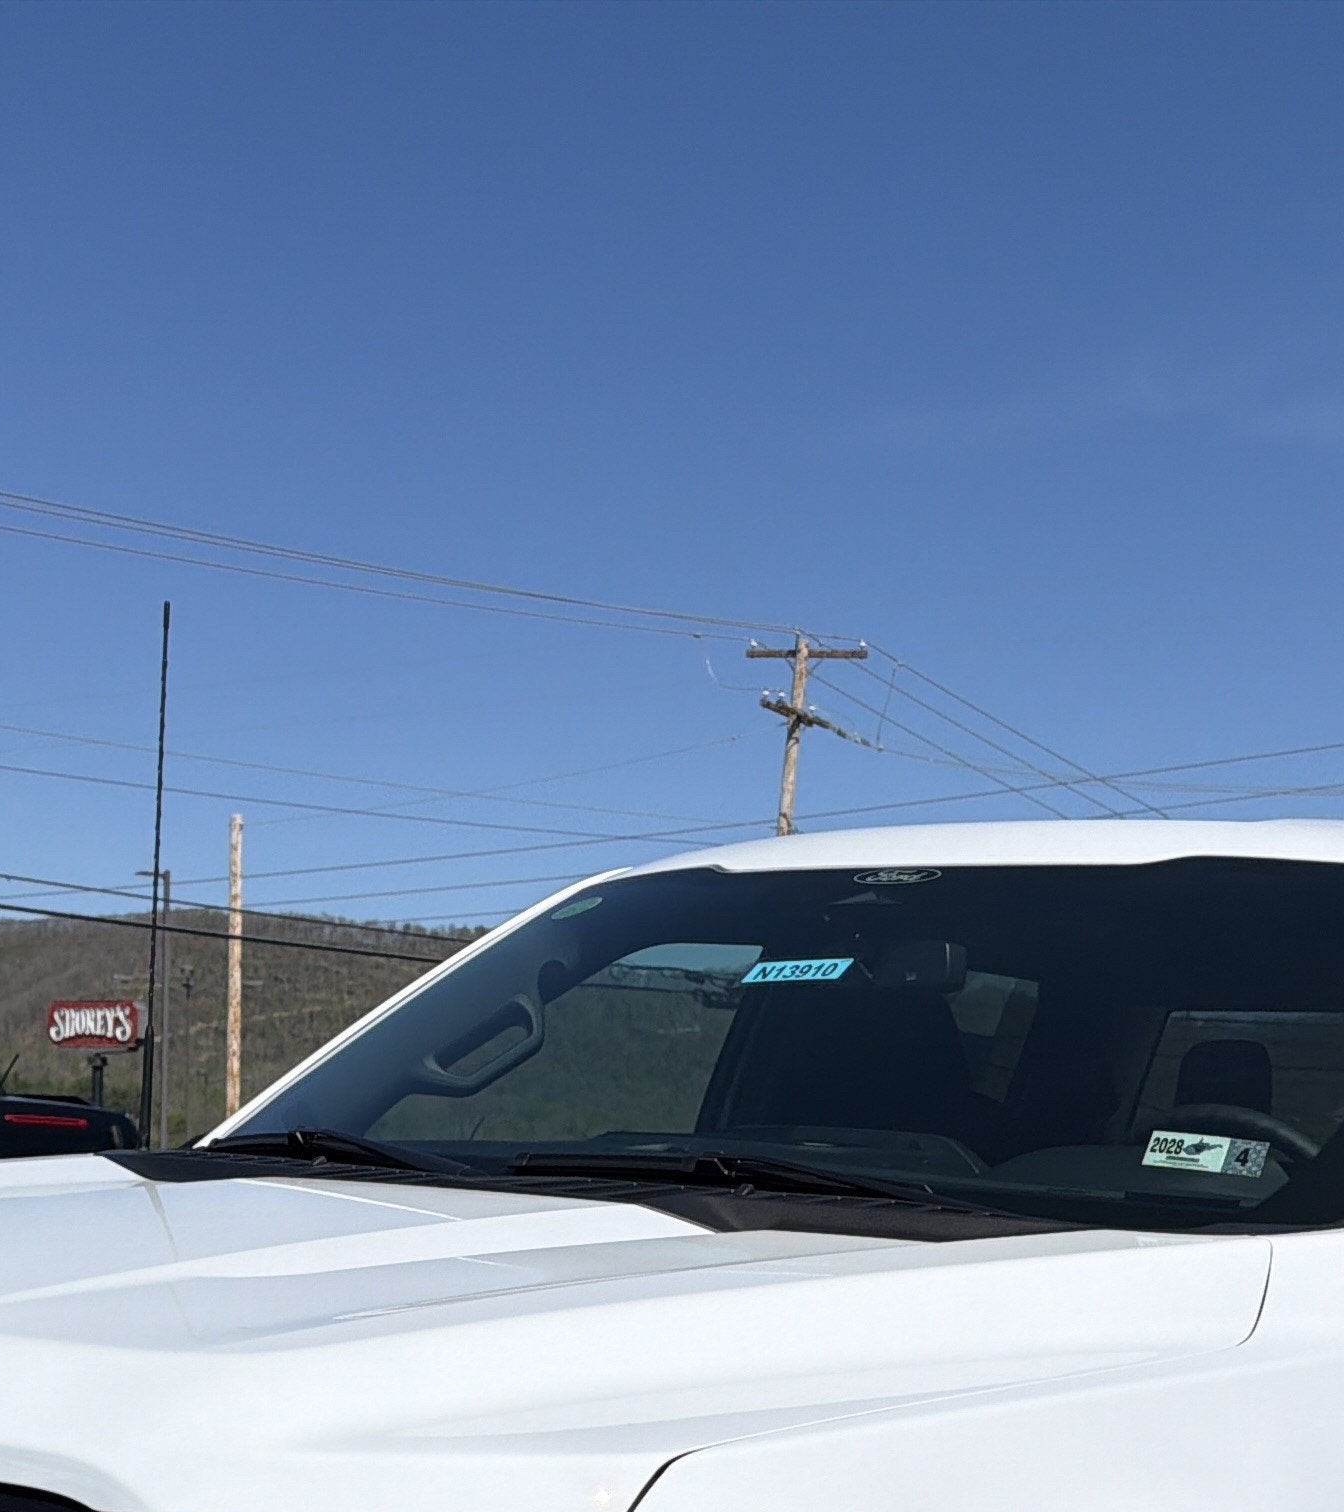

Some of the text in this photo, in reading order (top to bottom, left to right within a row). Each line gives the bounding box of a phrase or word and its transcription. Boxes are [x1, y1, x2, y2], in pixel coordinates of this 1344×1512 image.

[752, 962, 838, 981] N13910
[1149, 1136, 1185, 1155] 2028
[1233, 1147, 1253, 1168] 4
